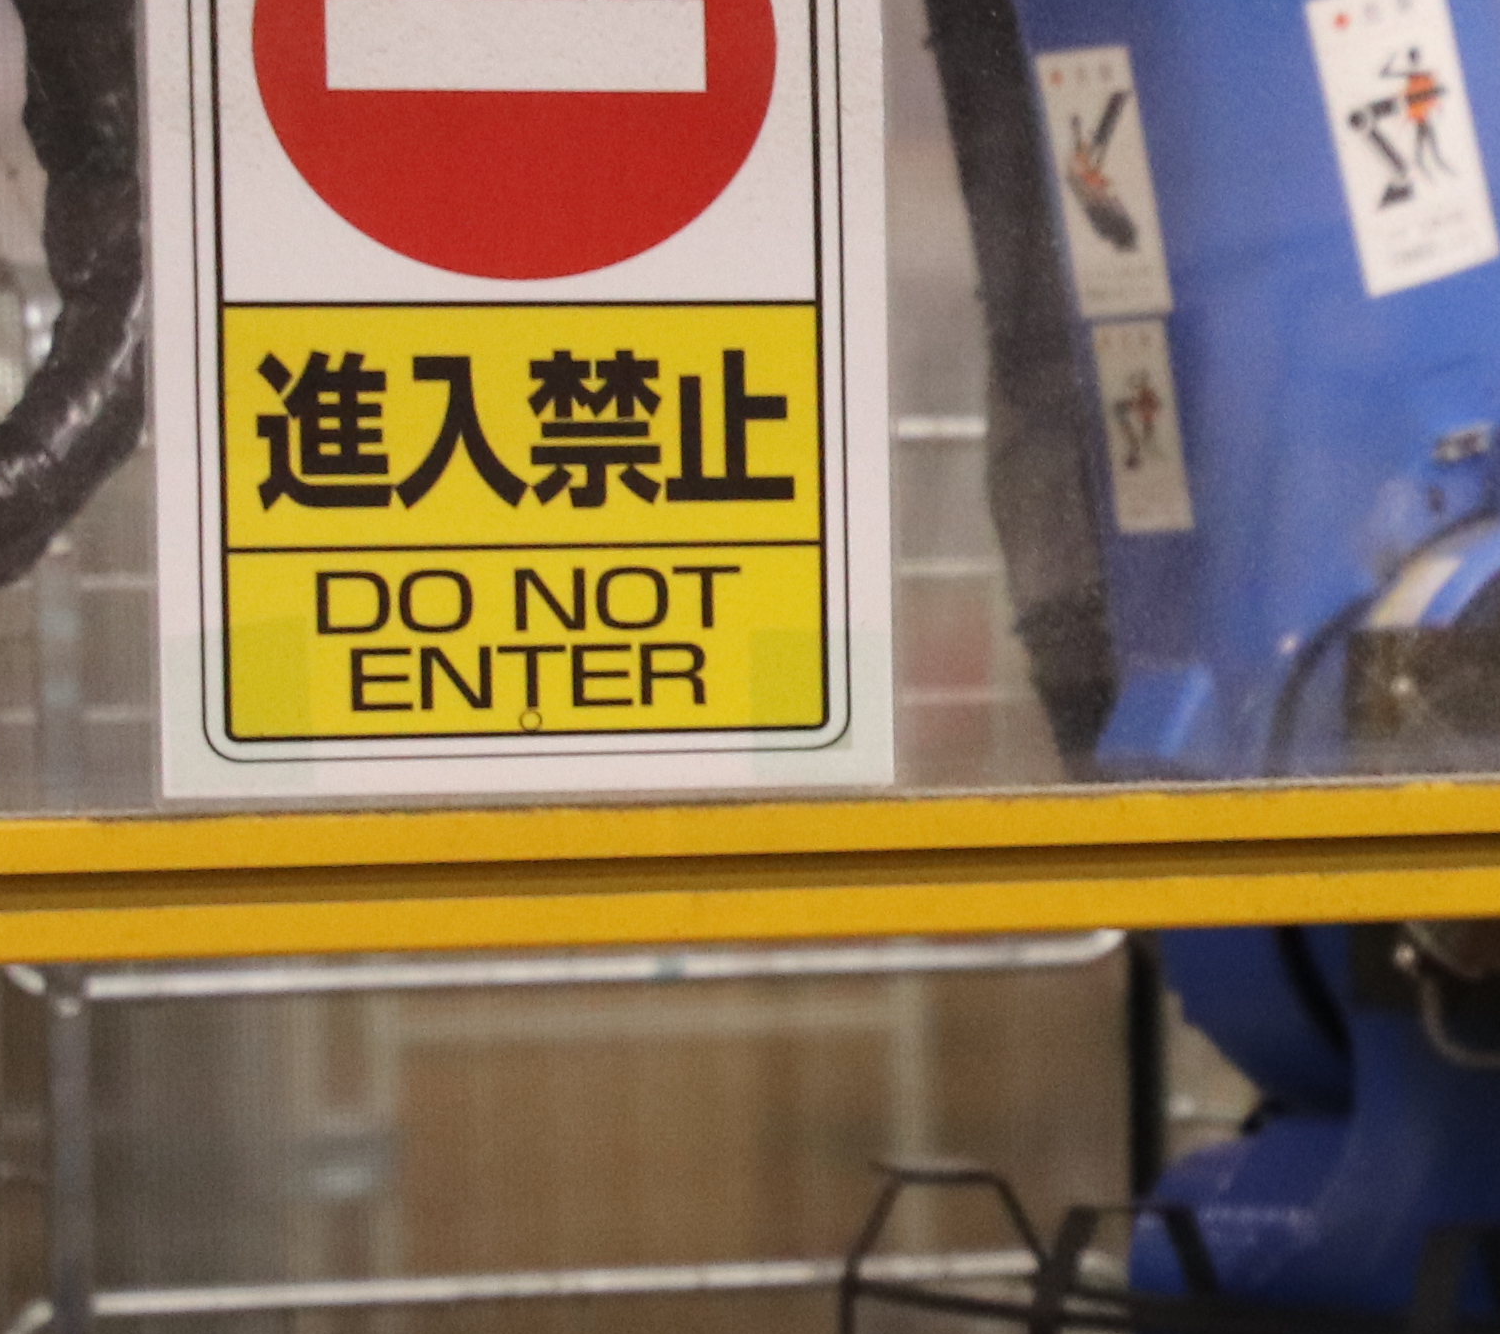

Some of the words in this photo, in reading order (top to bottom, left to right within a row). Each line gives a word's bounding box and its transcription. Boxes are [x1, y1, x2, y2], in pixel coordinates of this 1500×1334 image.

[256, 350, 795, 510] 進入禁止
[315, 568, 475, 636] DO
[513, 565, 743, 631] NOT
[348, 641, 709, 713] ENTER
